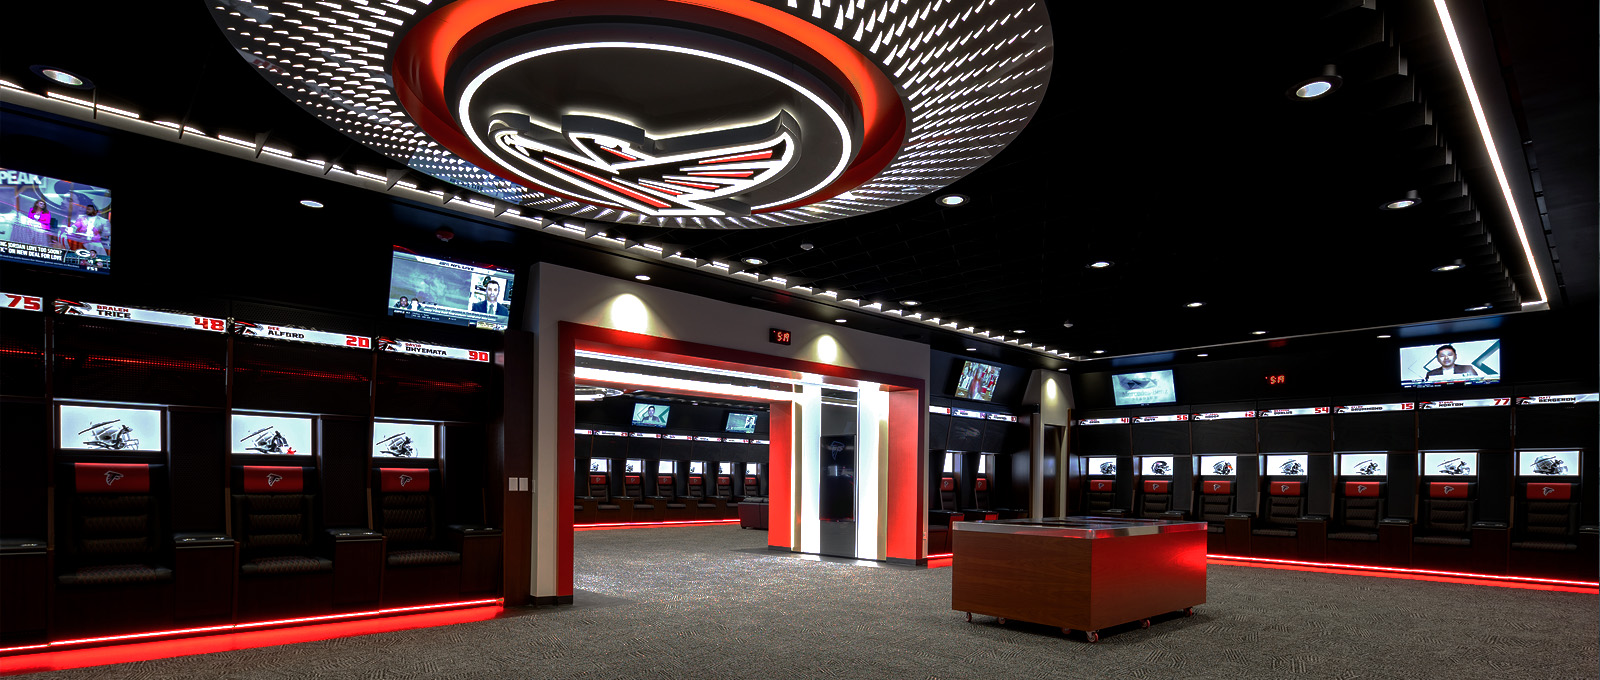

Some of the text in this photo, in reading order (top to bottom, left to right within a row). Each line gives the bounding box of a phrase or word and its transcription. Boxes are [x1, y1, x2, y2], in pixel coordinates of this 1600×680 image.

[0, 171, 42, 185] PEAK
[8, 242, 26, 250] JORDAN
[4, 294, 41, 310] 75
[97, 310, 132, 319] TRICE
[194, 317, 224, 331] 48
[268, 330, 305, 339] ALFORD
[346, 336, 370, 348] 20
[406, 346, 447, 355] ONYEMATA
[469, 351, 489, 361] 90
